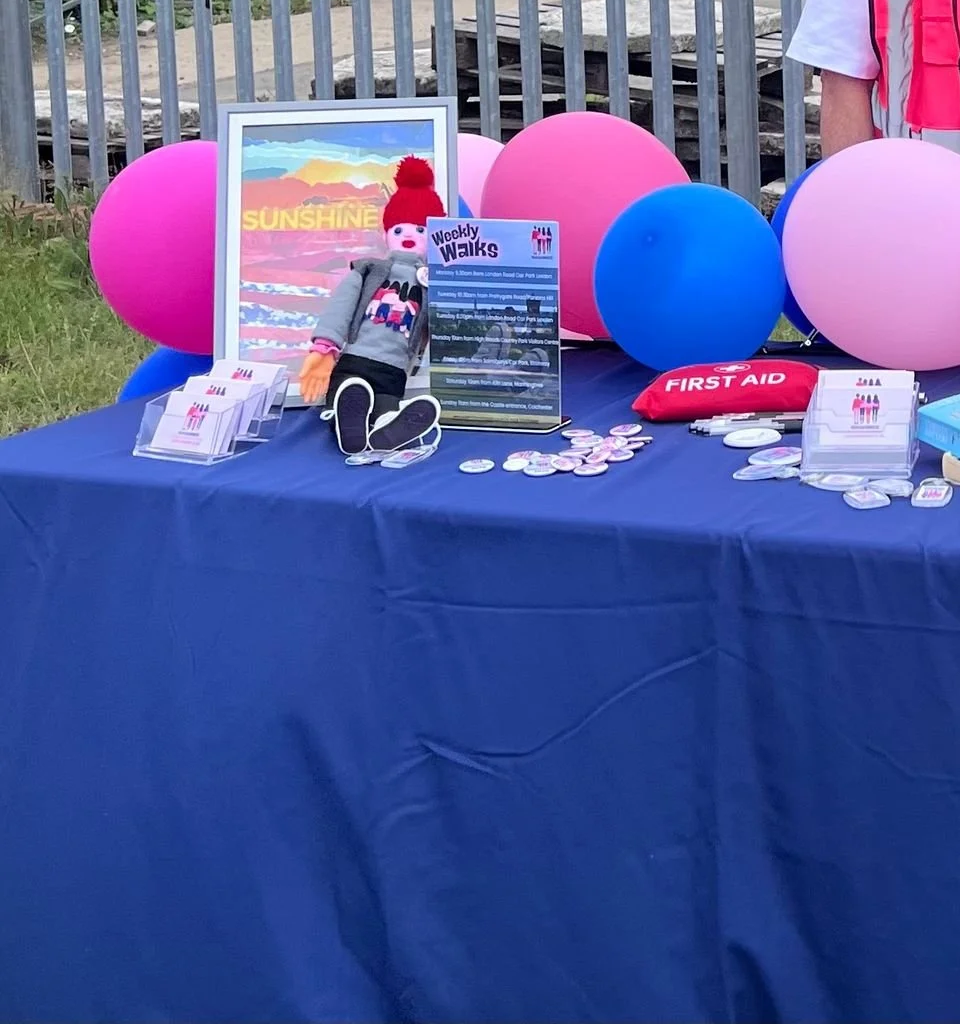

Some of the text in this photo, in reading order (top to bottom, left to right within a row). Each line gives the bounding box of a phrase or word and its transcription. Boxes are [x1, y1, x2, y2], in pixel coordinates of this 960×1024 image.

[242, 208, 378, 230] SUNSHINE
[432, 223, 479, 247] Weekly
[440, 239, 498, 263] Walks
[665, 372, 786, 392] FIRST AID
